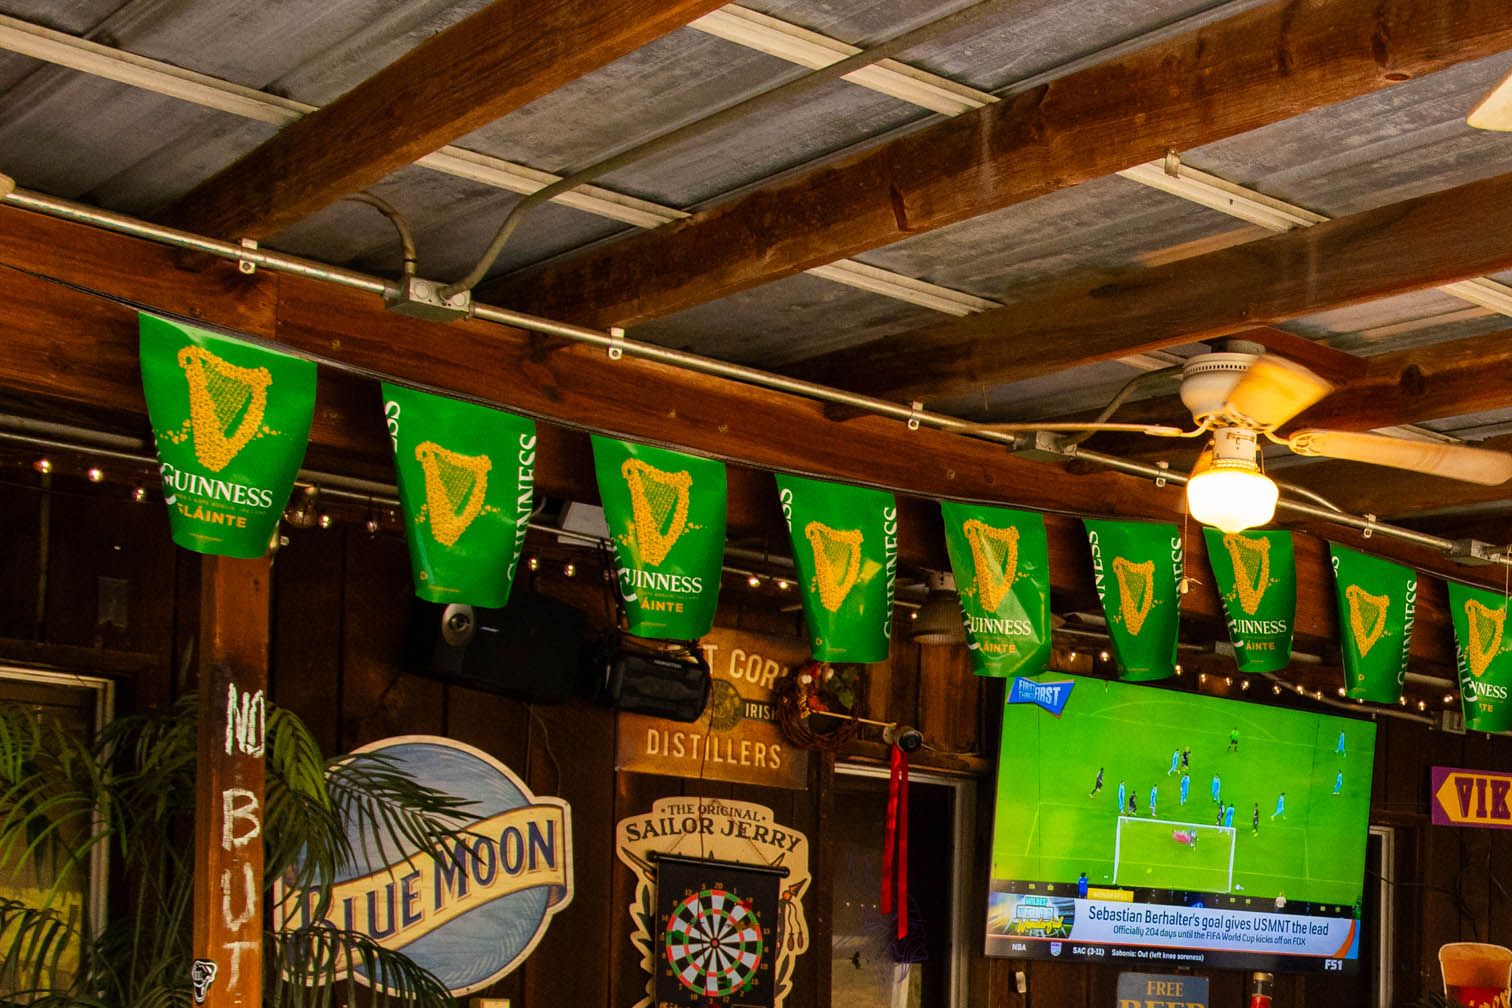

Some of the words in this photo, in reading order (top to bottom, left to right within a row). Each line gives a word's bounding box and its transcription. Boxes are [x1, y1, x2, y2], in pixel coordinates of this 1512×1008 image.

[160, 462, 273, 509] GUINNESS
[222, 683, 265, 758] NO
[646, 728, 782, 769] DISTILLERS
[667, 804, 695, 815] THE
[697, 804, 761, 822] ORIGINAL
[625, 817, 714, 843] SAILOR
[720, 818, 802, 853] JERRY
[433, 819, 558, 912] MOON
[1088, 905, 1142, 923] Sebastian
[1145, 909, 1200, 927] Berhalter's
[1202, 914, 1224, 931] goal
[1225, 915, 1251, 932] gives
[1253, 917, 1292, 933] USMNT
[1292, 921, 1307, 934] the
[1309, 922, 1329, 935] lead
[1113, 925, 1145, 936] Officially
[1145, 927, 1159, 937] 204
[1160, 928, 1177, 939] days
[1178, 930, 1193, 939] until
[1194, 930, 1205, 939] the
[1206, 931, 1221, 941] FIFA
[1222, 933, 1241, 942] World
[1242, 934, 1255, 944] Cup
[1255, 934, 1273, 944] kicks
[1274, 935, 1284, 944] off
[1283, 937, 1292, 945] on
[1292, 937, 1306, 946] FOX
[1072, 947, 1086, 955] SAC
[1111, 949, 1137, 958] Sabonis:
[1137, 950, 1149, 958] Out
[1149, 951, 1162, 960] (left
[1162, 952, 1177, 960] knee
[1177, 953, 1204, 962] soreness)
[1325, 959, 1343, 970] FS1
[1145, 980, 1184, 998] FREE
